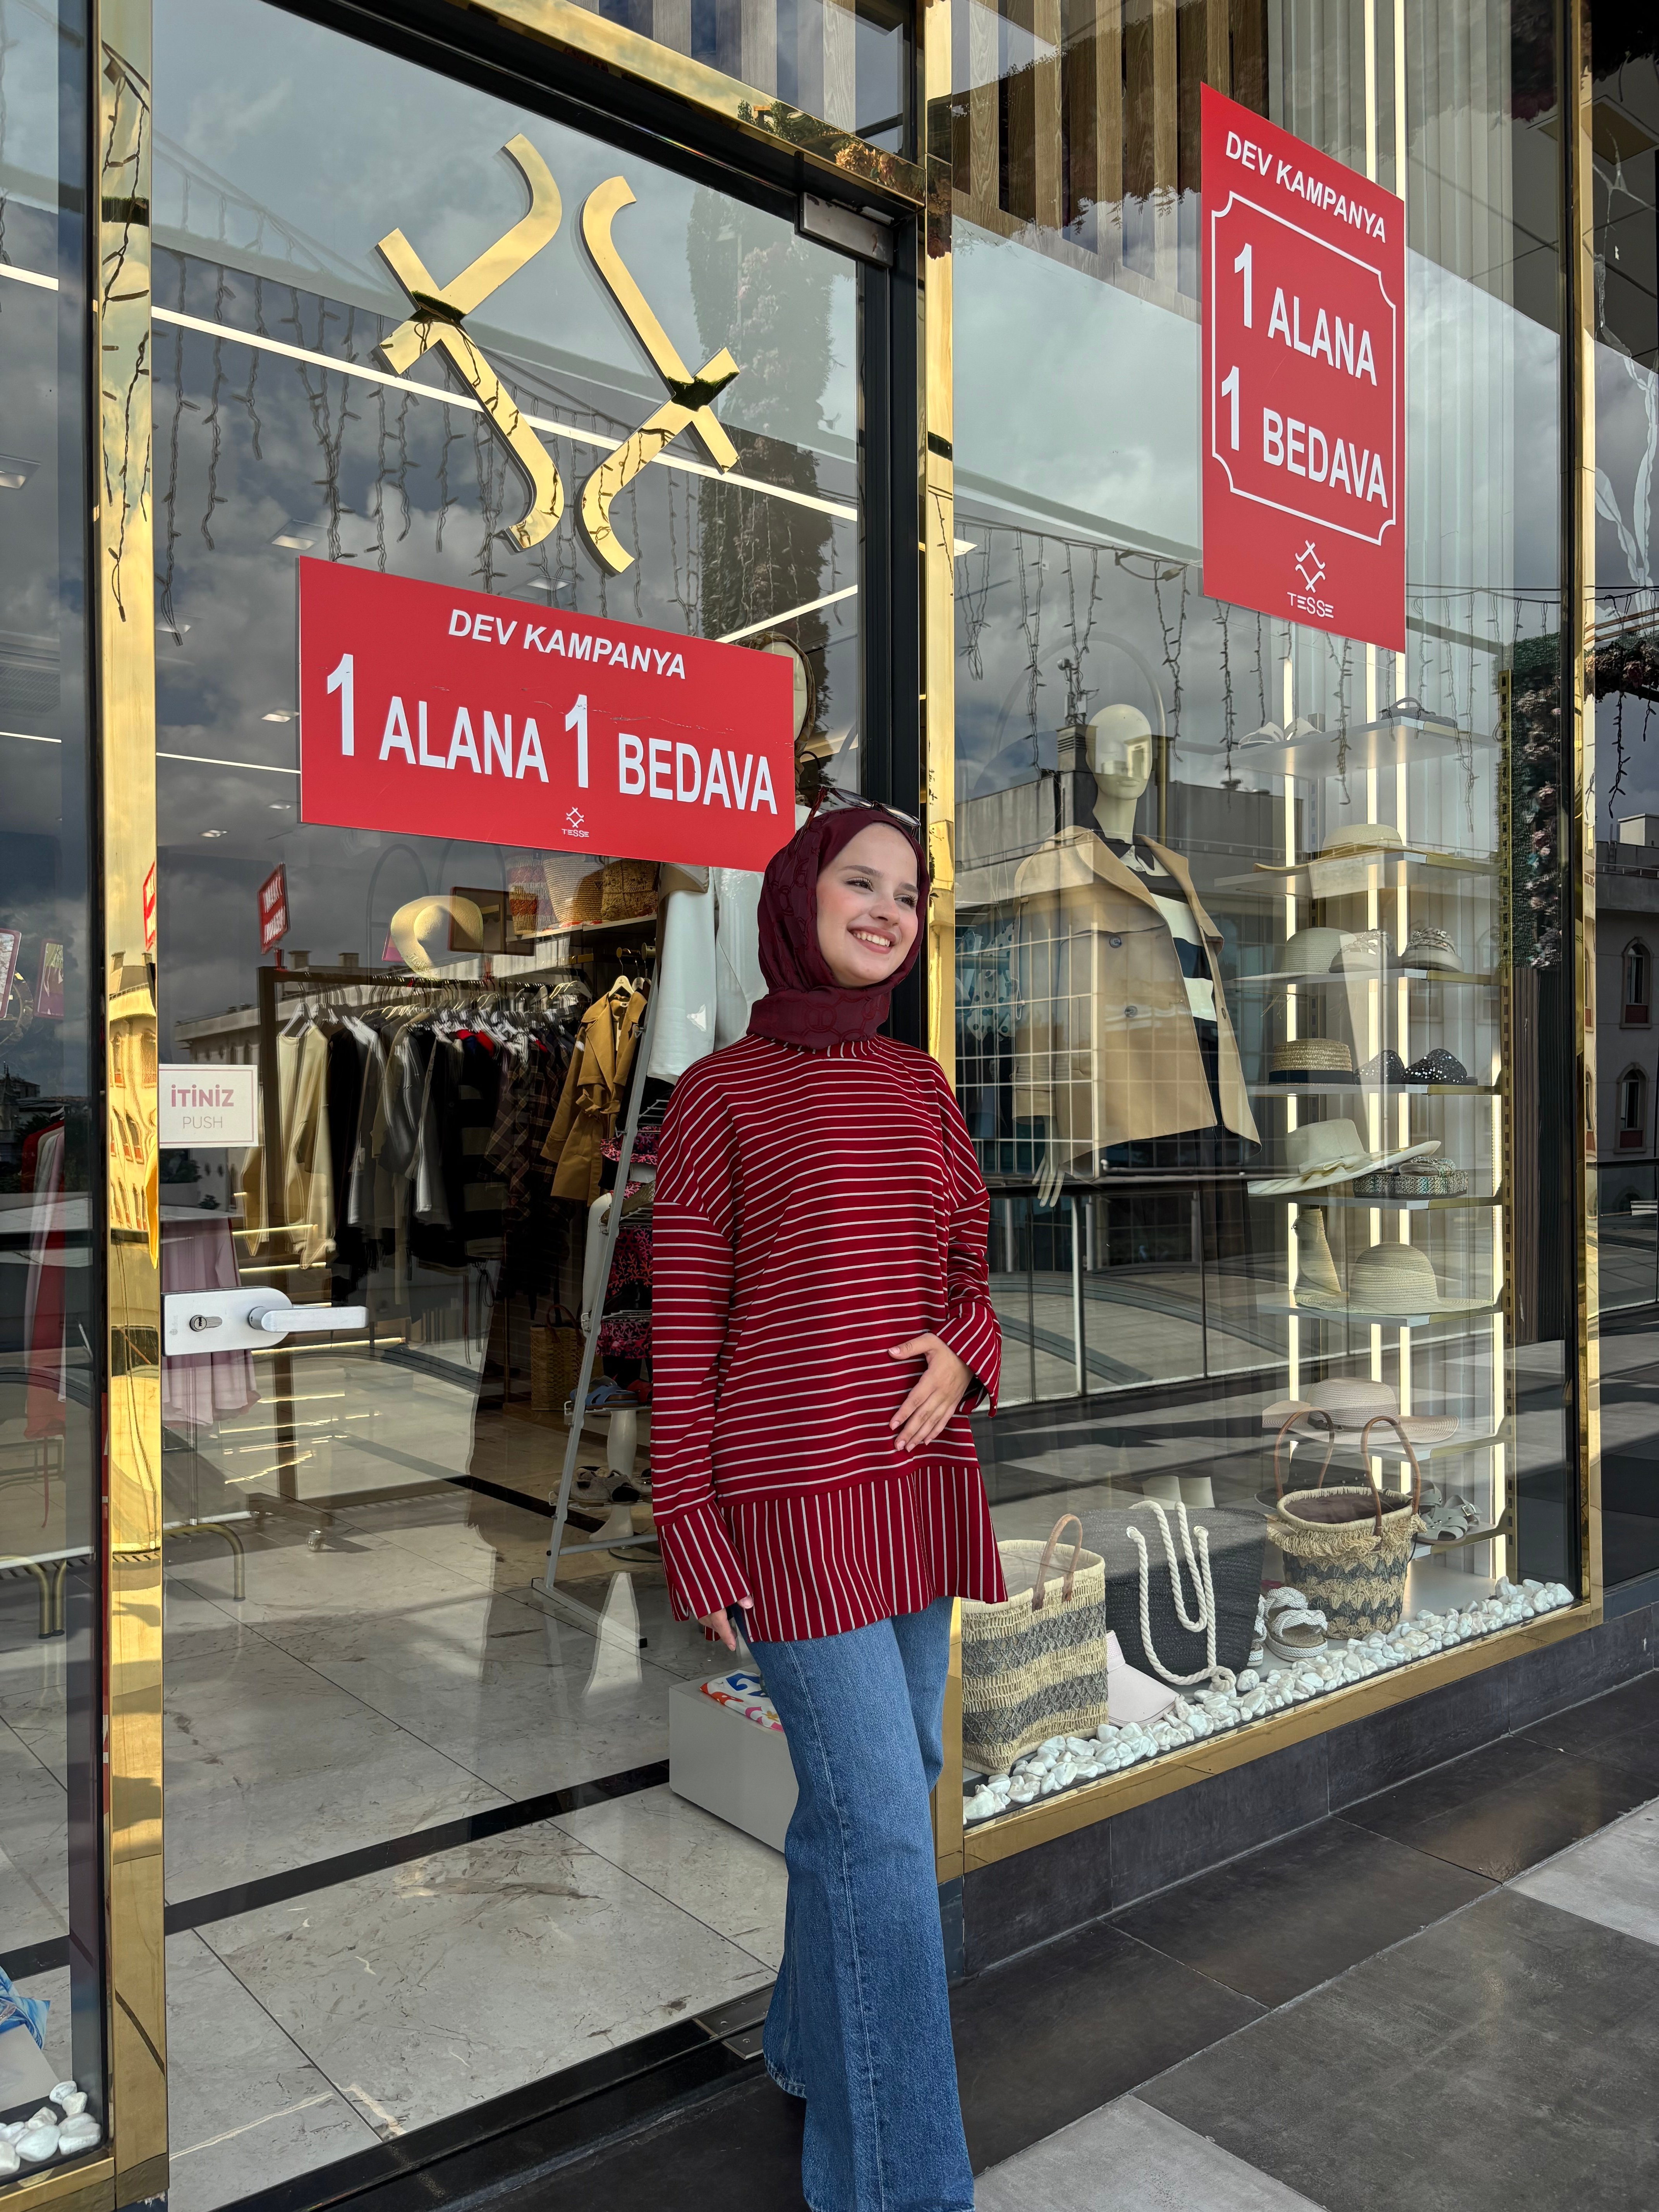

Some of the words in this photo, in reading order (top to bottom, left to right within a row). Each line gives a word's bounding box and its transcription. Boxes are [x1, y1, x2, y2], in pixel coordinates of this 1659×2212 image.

[1226, 131, 1273, 176] DEV
[1276, 160, 1386, 243] KAMPANYA
[1234, 243, 1252, 329] 1
[1267, 287, 1377, 386] ALANA
[1221, 365, 1239, 451] 1
[1263, 407, 1388, 508] BEDAVA
[1287, 592, 1334, 618] TESSE
[448, 609, 518, 645] DEV
[523, 624, 685, 679] KAMPANYA
[327, 653, 354, 756] 1
[379, 696, 549, 783] ALANA
[565, 694, 589, 788] 1
[618, 733, 778, 815] BEDAVA
[561, 828, 589, 838] TESSE
[171, 1084, 234, 1107] İTİNİZ
[183, 1116, 223, 1129] PUSH
